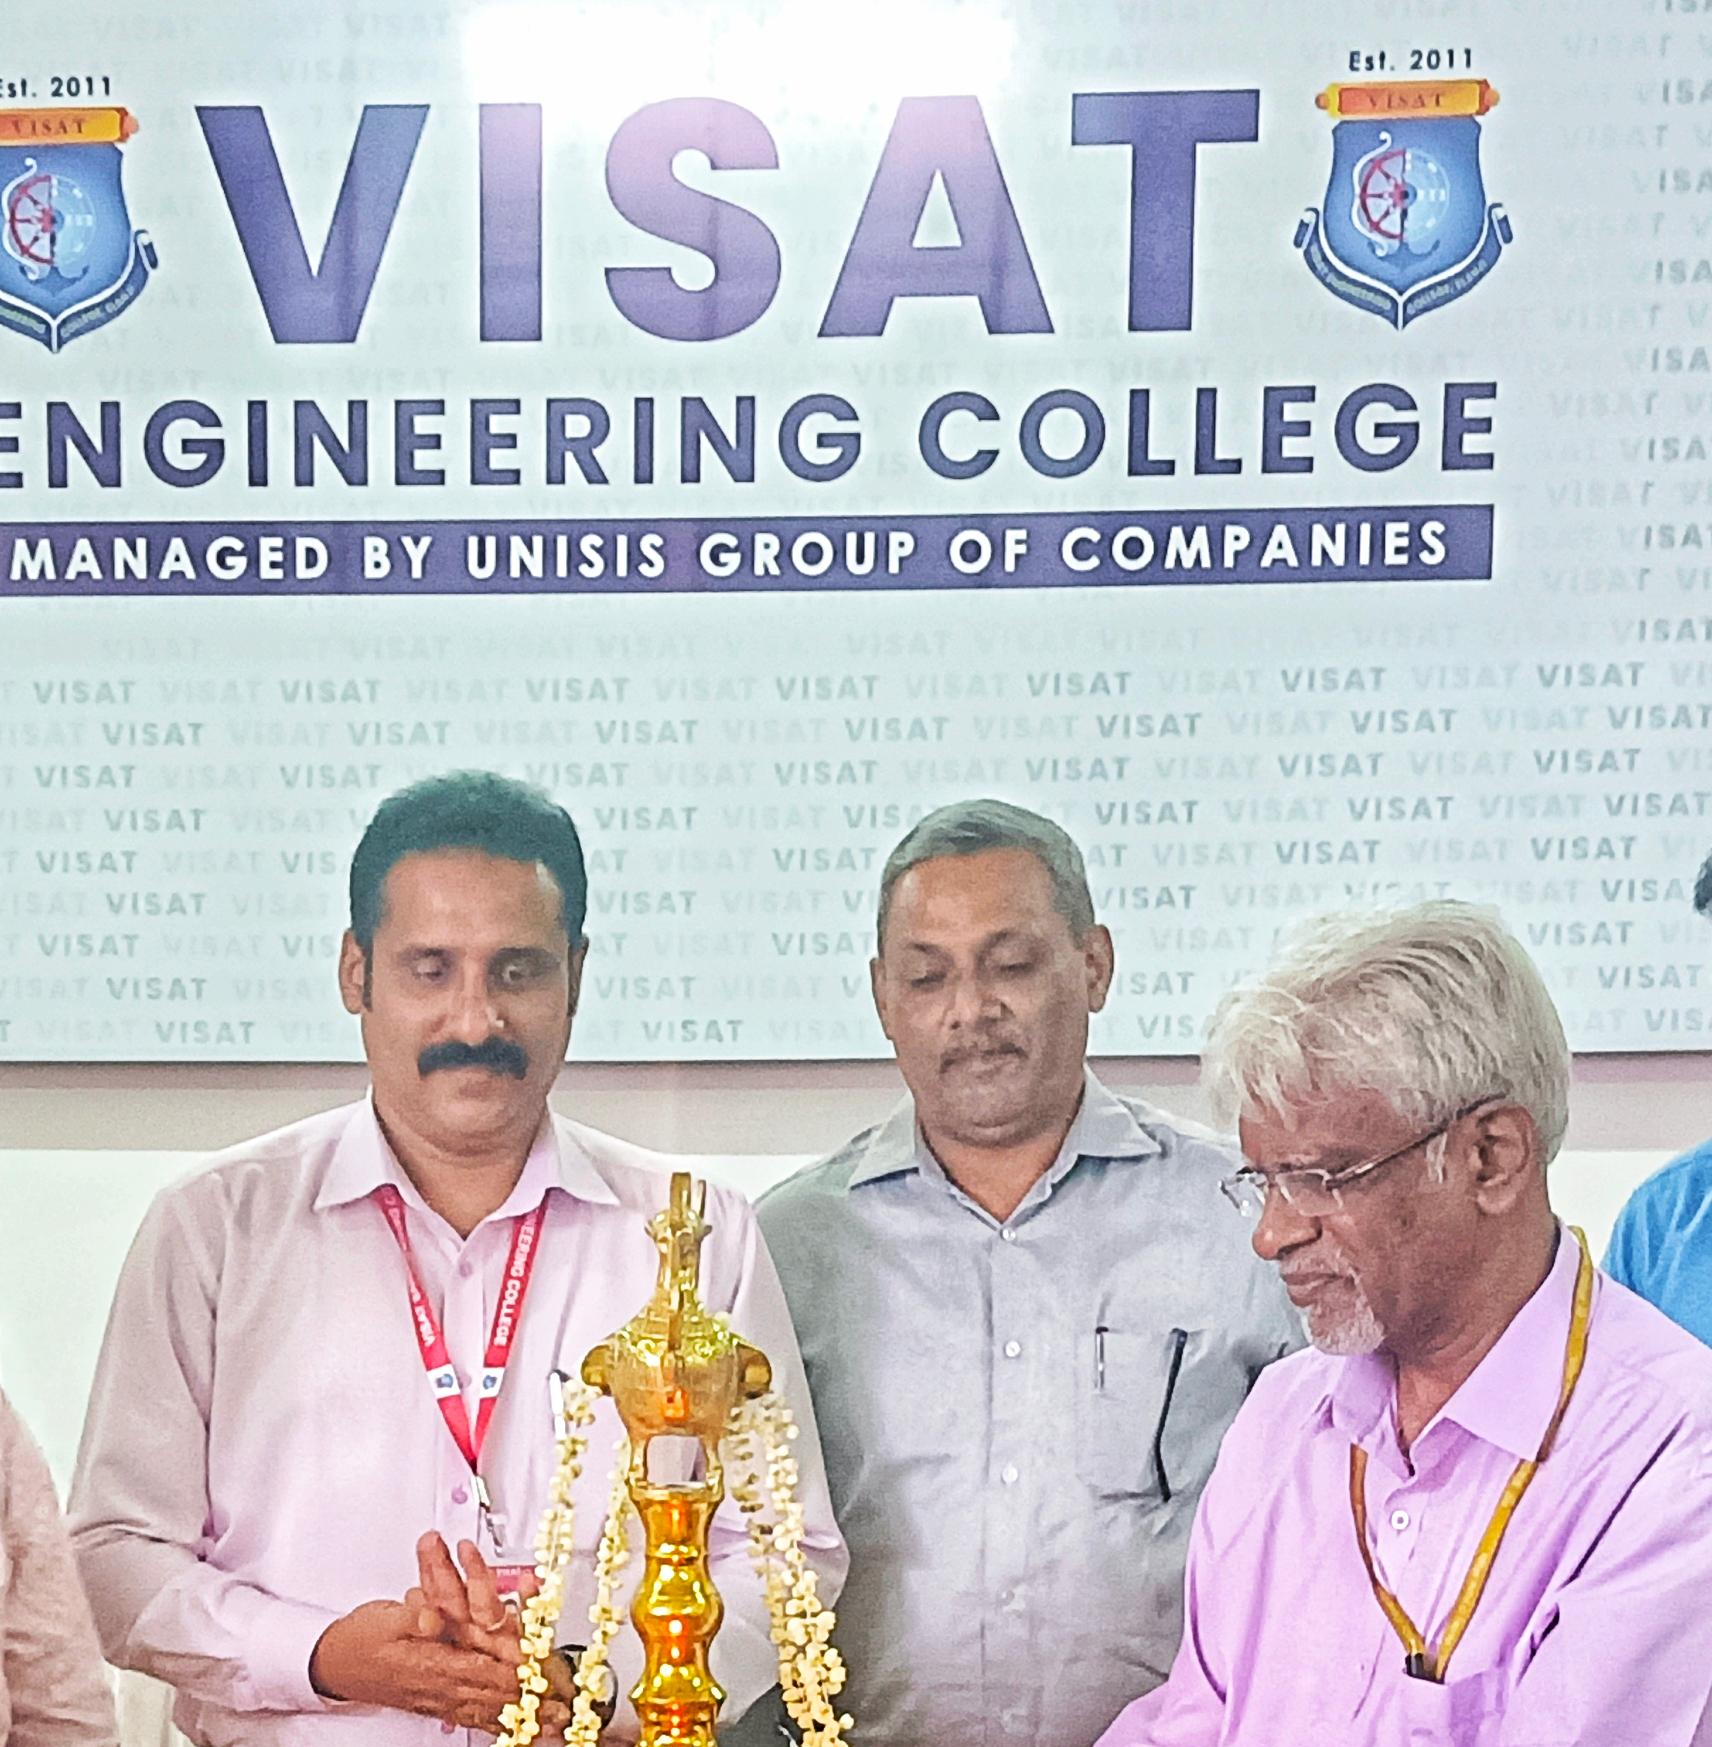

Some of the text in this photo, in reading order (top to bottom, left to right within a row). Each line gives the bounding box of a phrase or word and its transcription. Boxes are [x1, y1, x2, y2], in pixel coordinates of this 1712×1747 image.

[1349, 48, 1472, 72] Est. 2011
[51, 76, 111, 99] 2011
[1365, 93, 1445, 109] VISAT
[10, 118, 88, 136] VISAT
[194, 89, 1262, 346] VISAT
[918, 382, 1499, 482] COLLEGE
[9, 521, 1447, 582] MANAGED BY UNISIS GROUP OF COMPANIES
[32, 680, 136, 705] VISAT
[278, 679, 382, 704] VISAT
[525, 678, 629, 703] VISAT
[773, 677, 880, 702] VISAT
[1025, 673, 1132, 698] VISAT
[1280, 668, 1387, 692] VISAT
[1535, 662, 1645, 688] VISAT
[104, 721, 205, 746] VISAT
[346, 720, 451, 746] VISAT
[593, 721, 700, 746] VISAT
[842, 719, 949, 744] VISAT
[1095, 714, 1202, 738] VISAT
[1348, 708, 1458, 734] VISAT
[33, 764, 137, 789] VISAT
[279, 765, 381, 790] VISAT
[772, 762, 879, 787] VISAT
[1023, 759, 1130, 784] VISAT
[1275, 752, 1385, 778] VISAT
[1532, 748, 1642, 774] VISAT
[103, 808, 207, 833] VISAT
[596, 805, 697, 830] VISAT
[1093, 801, 1200, 825] VISAT
[1347, 797, 1454, 821] VISAT
[1603, 793, 1710, 817] VISAT
[35, 850, 139, 875] VISAT
[280, 851, 336, 874] VIS
[771, 846, 876, 872] VISAT
[1274, 841, 1381, 865] VISAT
[1528, 835, 1638, 861] VISAT
[104, 892, 208, 917] VISAT
[594, 890, 696, 915] VISAT
[1601, 879, 1690, 903] VISA
[36, 933, 140, 958] VISAT
[1528, 921, 1634, 946] VISAT
[107, 976, 208, 1001] VISAT
[594, 976, 695, 1000] VISAT
[1117, 972, 1194, 996] ISAT
[1595, 966, 1702, 991] VISAT
[155, 1018, 256, 1043] VISAT
[642, 1017, 743, 1042] VISAT
[493, 1279, 521, 1347] COLLEGE
